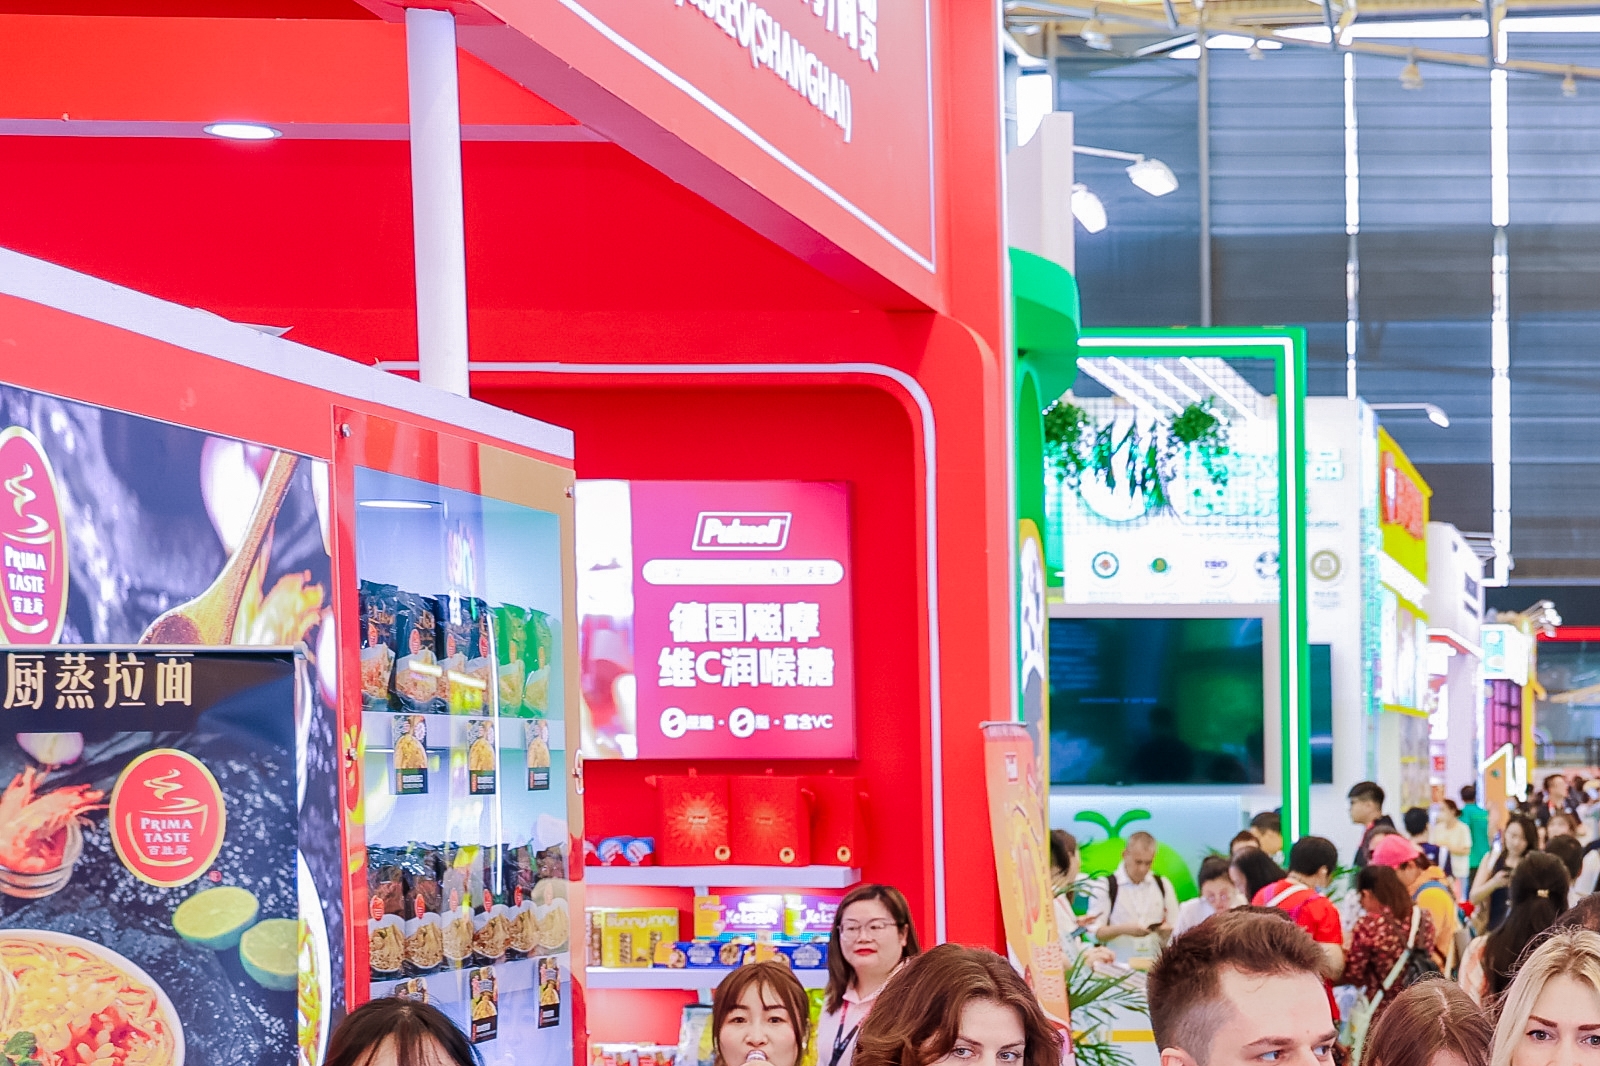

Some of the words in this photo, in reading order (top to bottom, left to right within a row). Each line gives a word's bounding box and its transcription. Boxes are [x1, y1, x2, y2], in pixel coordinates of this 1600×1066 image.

[4, 546, 47, 572] PRIMA
[7, 573, 45, 594] TASTE
[3, 652, 195, 710] 厨蒸拉面
[140, 817, 194, 832] PRIMA
[144, 831, 191, 843] TASTE
